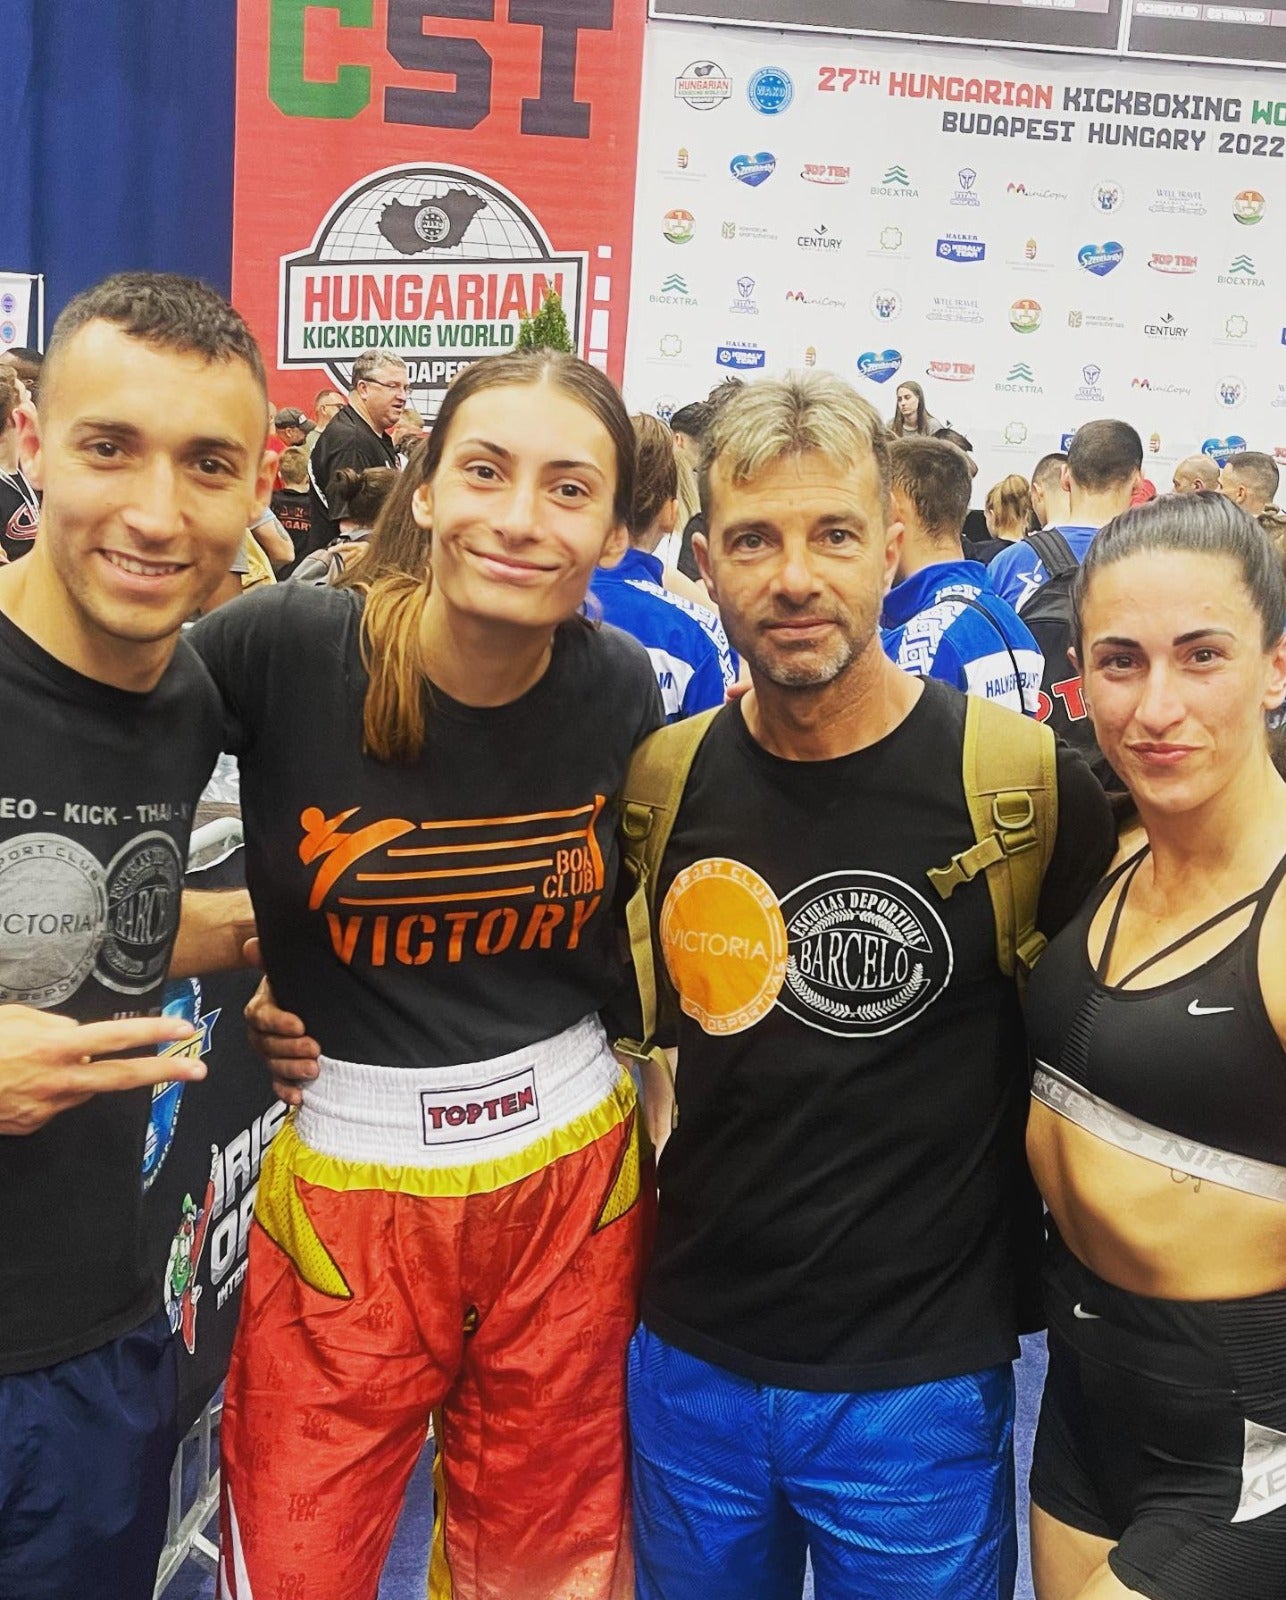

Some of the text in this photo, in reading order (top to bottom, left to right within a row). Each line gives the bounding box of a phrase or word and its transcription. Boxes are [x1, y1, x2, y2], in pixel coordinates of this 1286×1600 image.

[678, 80, 729, 91] HUNGARIAN
[888, 71, 1053, 110] HUNGARIAN
[1063, 86, 1242, 123] KICKBOXING
[942, 111, 1285, 158] BUDAPEST HUNGARY 2022
[870, 186, 919, 198] BIOEXTRA
[797, 236, 842, 249] CENTURY
[1217, 275, 1266, 288] BIOEXTRA
[303, 272, 564, 322] HUNGARIAN
[649, 295, 698, 307] BIOEXTRA
[303, 324, 514, 349] KICKBOXING WORLD
[1144, 325, 1188, 337] CENTURY
[995, 383, 1044, 395] BIOEXTRA
[64, 803, 118, 826] KICK
[543, 868, 594, 898] CLUB
[673, 863, 775, 910] SPORT CLUB
[326, 894, 600, 966] VICTORY
[789, 891, 926, 946] ESCUELAS DEPORTIVAS
[668, 927, 769, 963] VICTORIA
[800, 931, 909, 991] BARCELO
